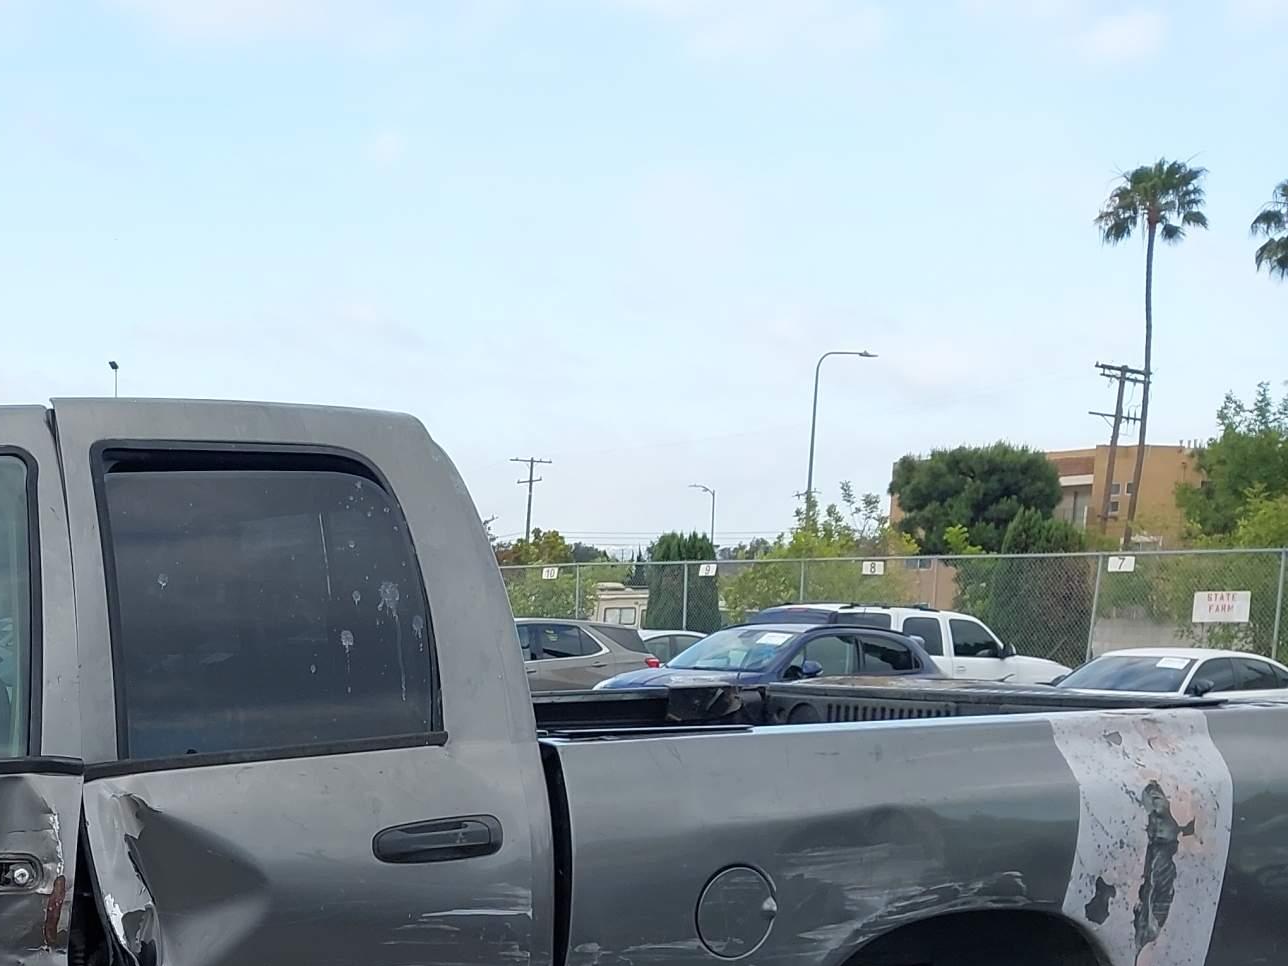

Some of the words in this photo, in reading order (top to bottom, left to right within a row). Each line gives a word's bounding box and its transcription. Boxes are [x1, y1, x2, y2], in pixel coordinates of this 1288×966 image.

[870, 562, 877, 574] 8
[1118, 557, 1126, 570] 7
[544, 568, 556, 578] 10
[1207, 592, 1238, 602] STATE
[1208, 603, 1234, 614] FARM
